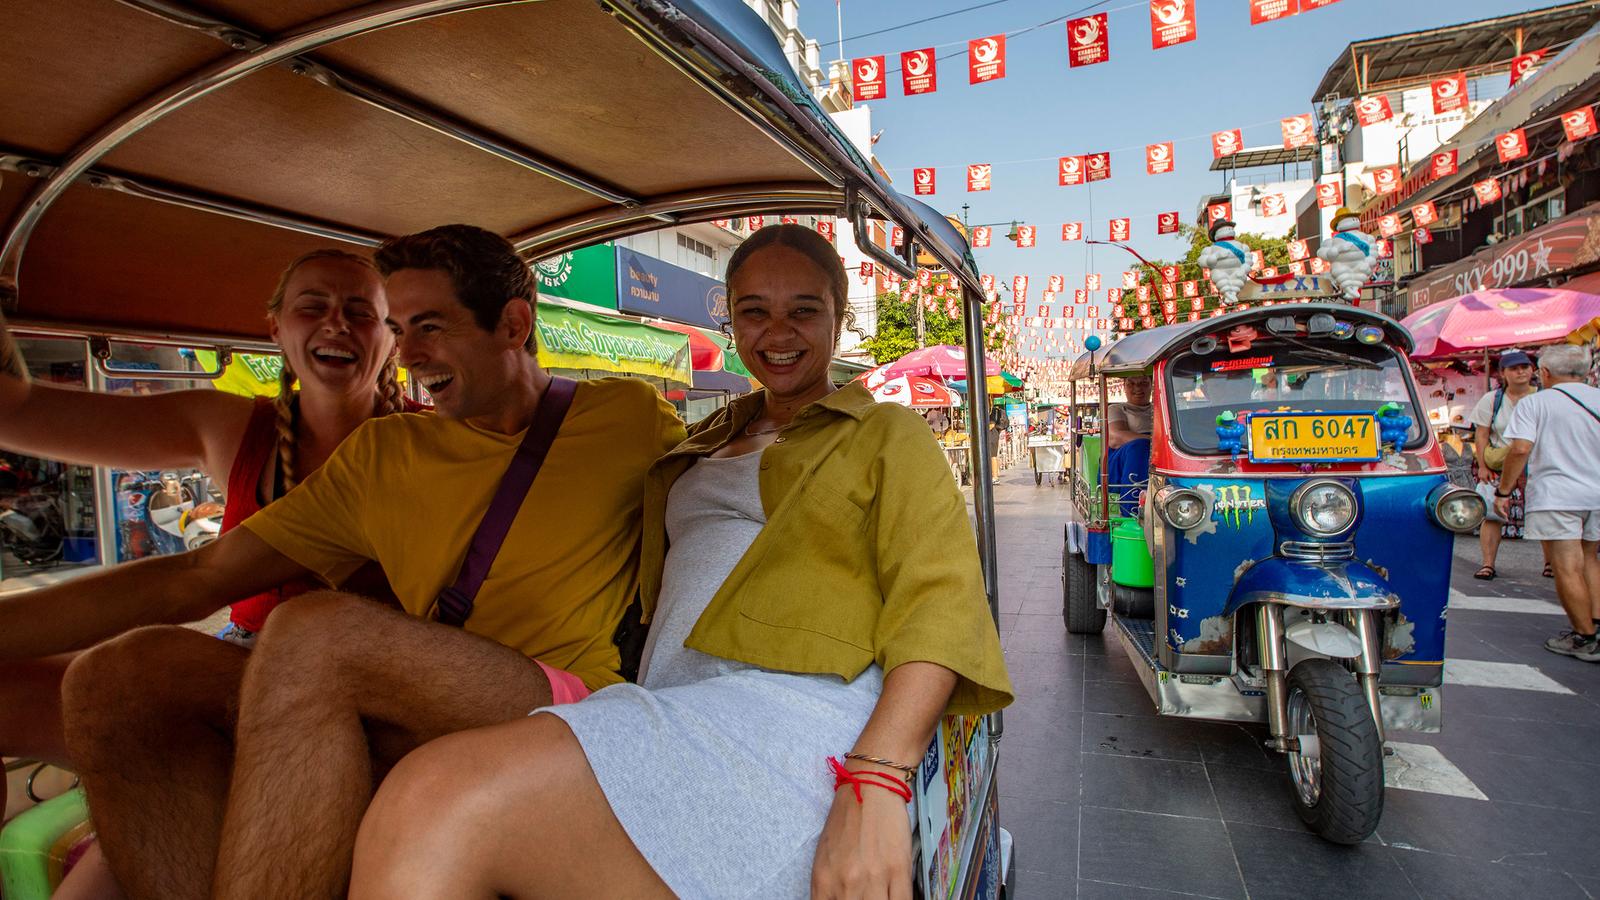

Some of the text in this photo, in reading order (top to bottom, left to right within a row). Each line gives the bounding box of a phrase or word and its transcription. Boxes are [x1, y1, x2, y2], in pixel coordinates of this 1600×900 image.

[1455, 249, 1529, 296] SKY 999
[535, 317, 588, 353] Fresh
[579, 322, 653, 366] Sugarcane
[1264, 418, 1370, 440] สก 6047
[1271, 445, 1358, 458] กรุงเทพมหานคร
